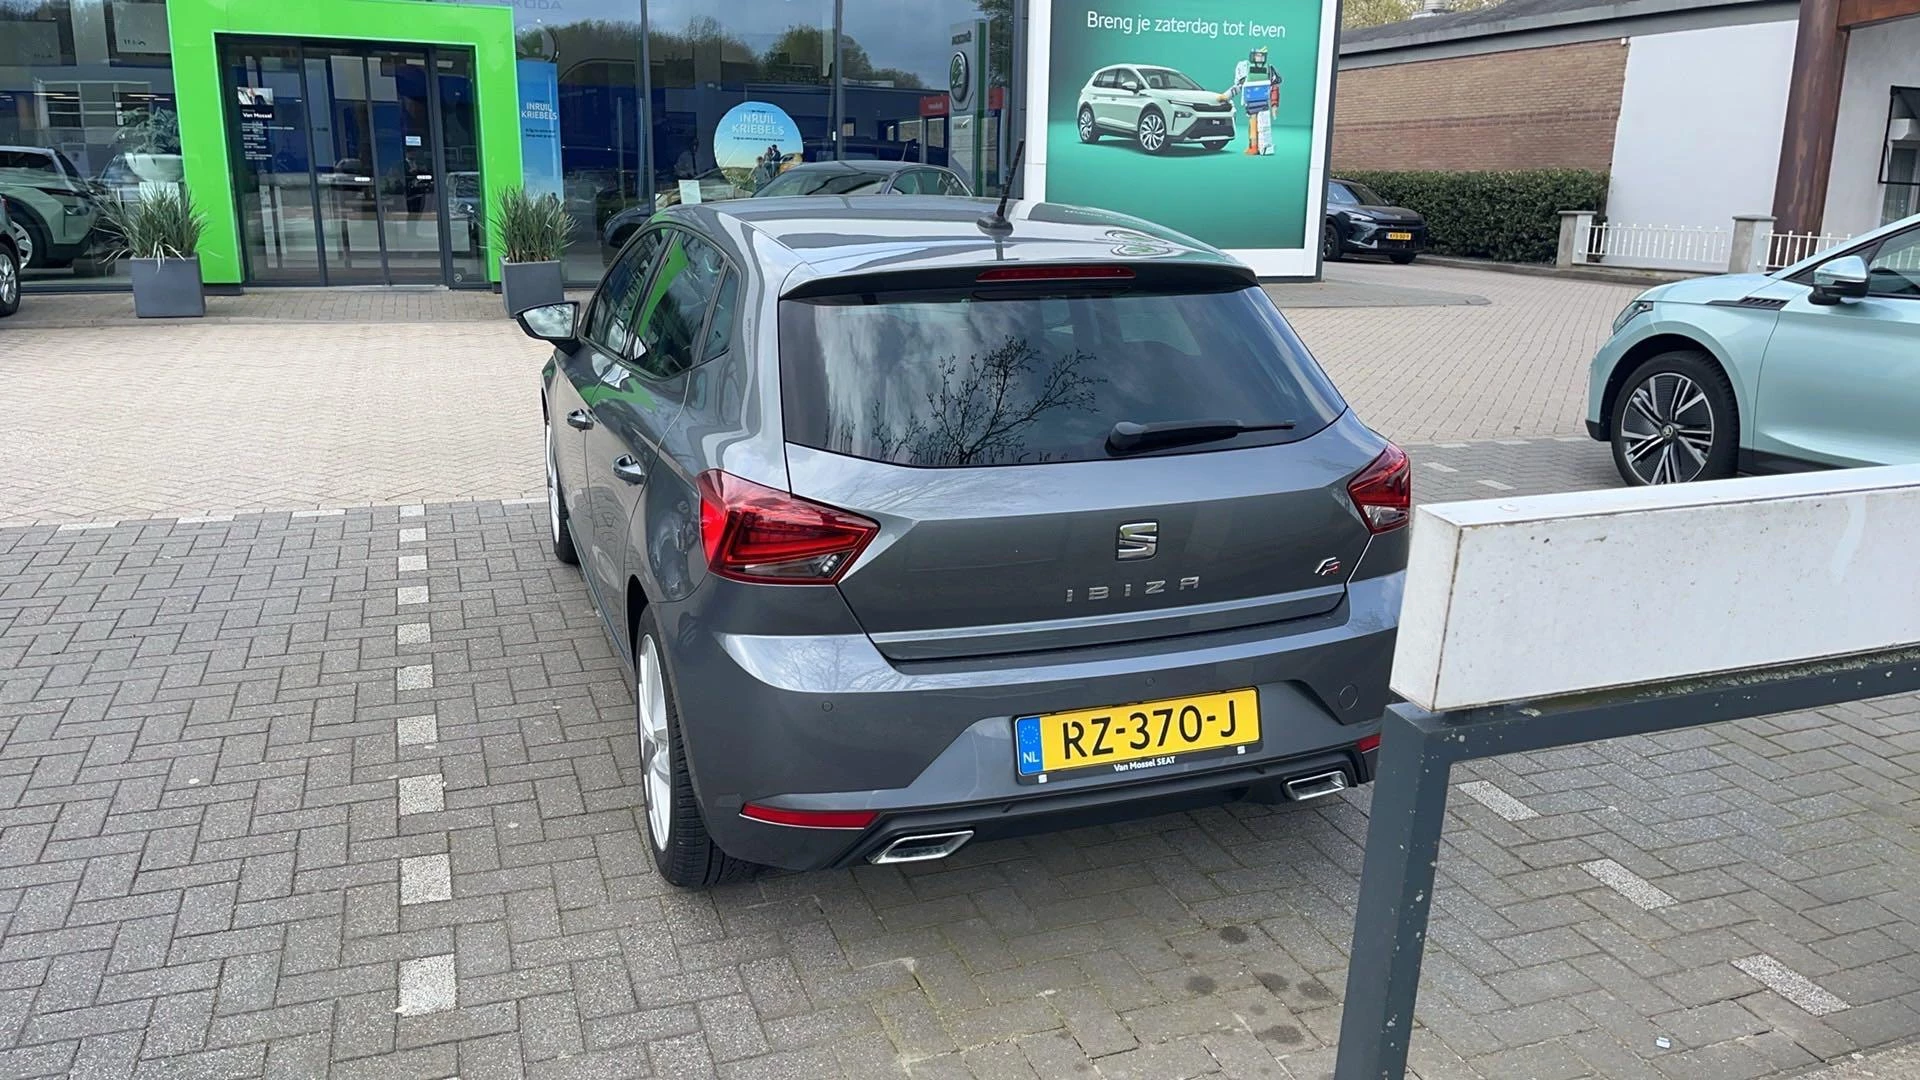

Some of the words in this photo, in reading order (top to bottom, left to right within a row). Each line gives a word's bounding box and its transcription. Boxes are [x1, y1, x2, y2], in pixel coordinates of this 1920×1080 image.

[1087, 11, 1132, 34] Breng
[1136, 14, 1151, 35] je
[1154, 18, 1218, 39] zaterdag
[1222, 20, 1244, 36] tot
[1248, 21, 1286, 38] leven
[526, 102, 553, 112] INRUIL
[521, 110, 558, 120] KRIEBELS
[740, 113, 777, 124] INRUIL
[731, 123, 785, 136] KRIEBELS
[1066, 576, 1200, 602] IBIZA
[1062, 700, 1237, 760] RZ-370-J
[1023, 751, 1040, 764] NL
[1113, 763, 1129, 772] Van
[1129, 759, 1157, 771] Mossel
[1157, 756, 1176, 766] SEAT
